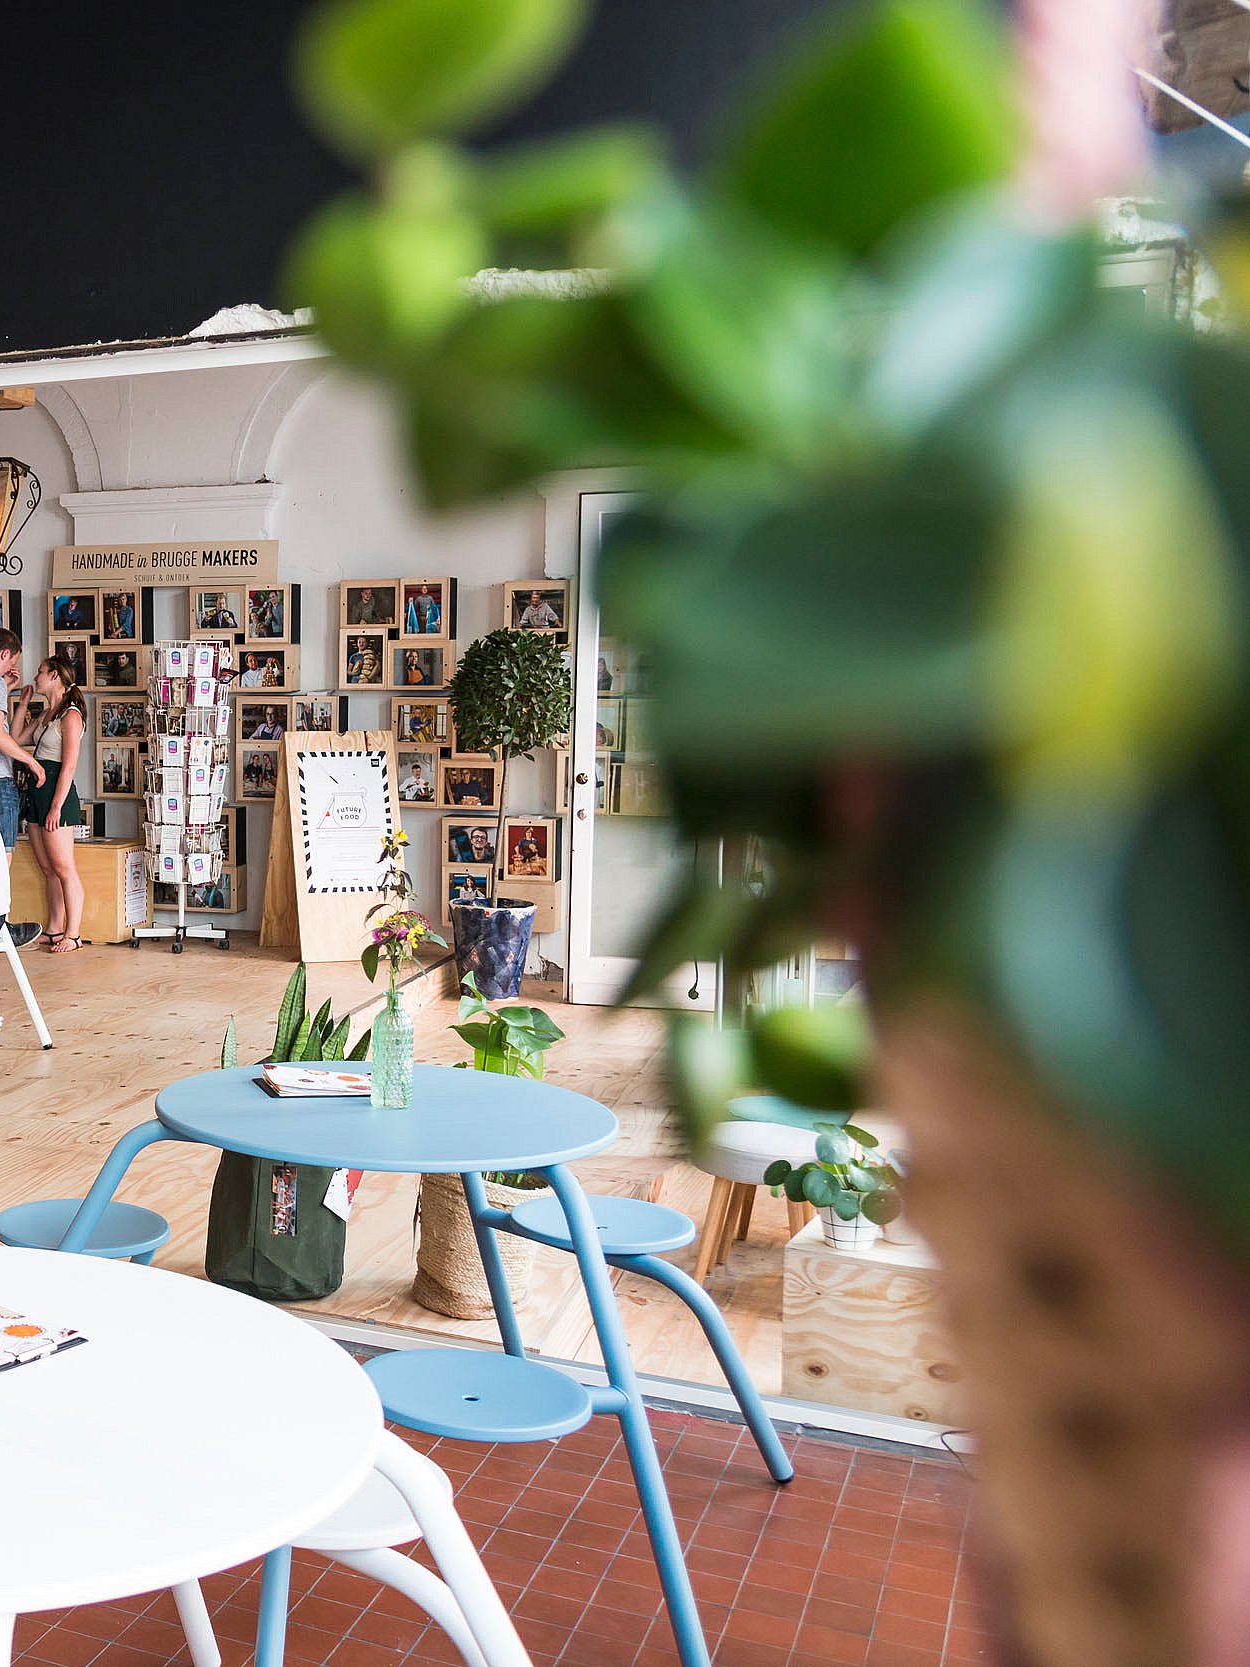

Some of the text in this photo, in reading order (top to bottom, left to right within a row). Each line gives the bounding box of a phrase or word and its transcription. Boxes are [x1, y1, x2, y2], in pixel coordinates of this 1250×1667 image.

[72, 549, 258, 570] HANDMADE in BRUGGE MAKERS
[336, 806, 362, 814] FUTURE
